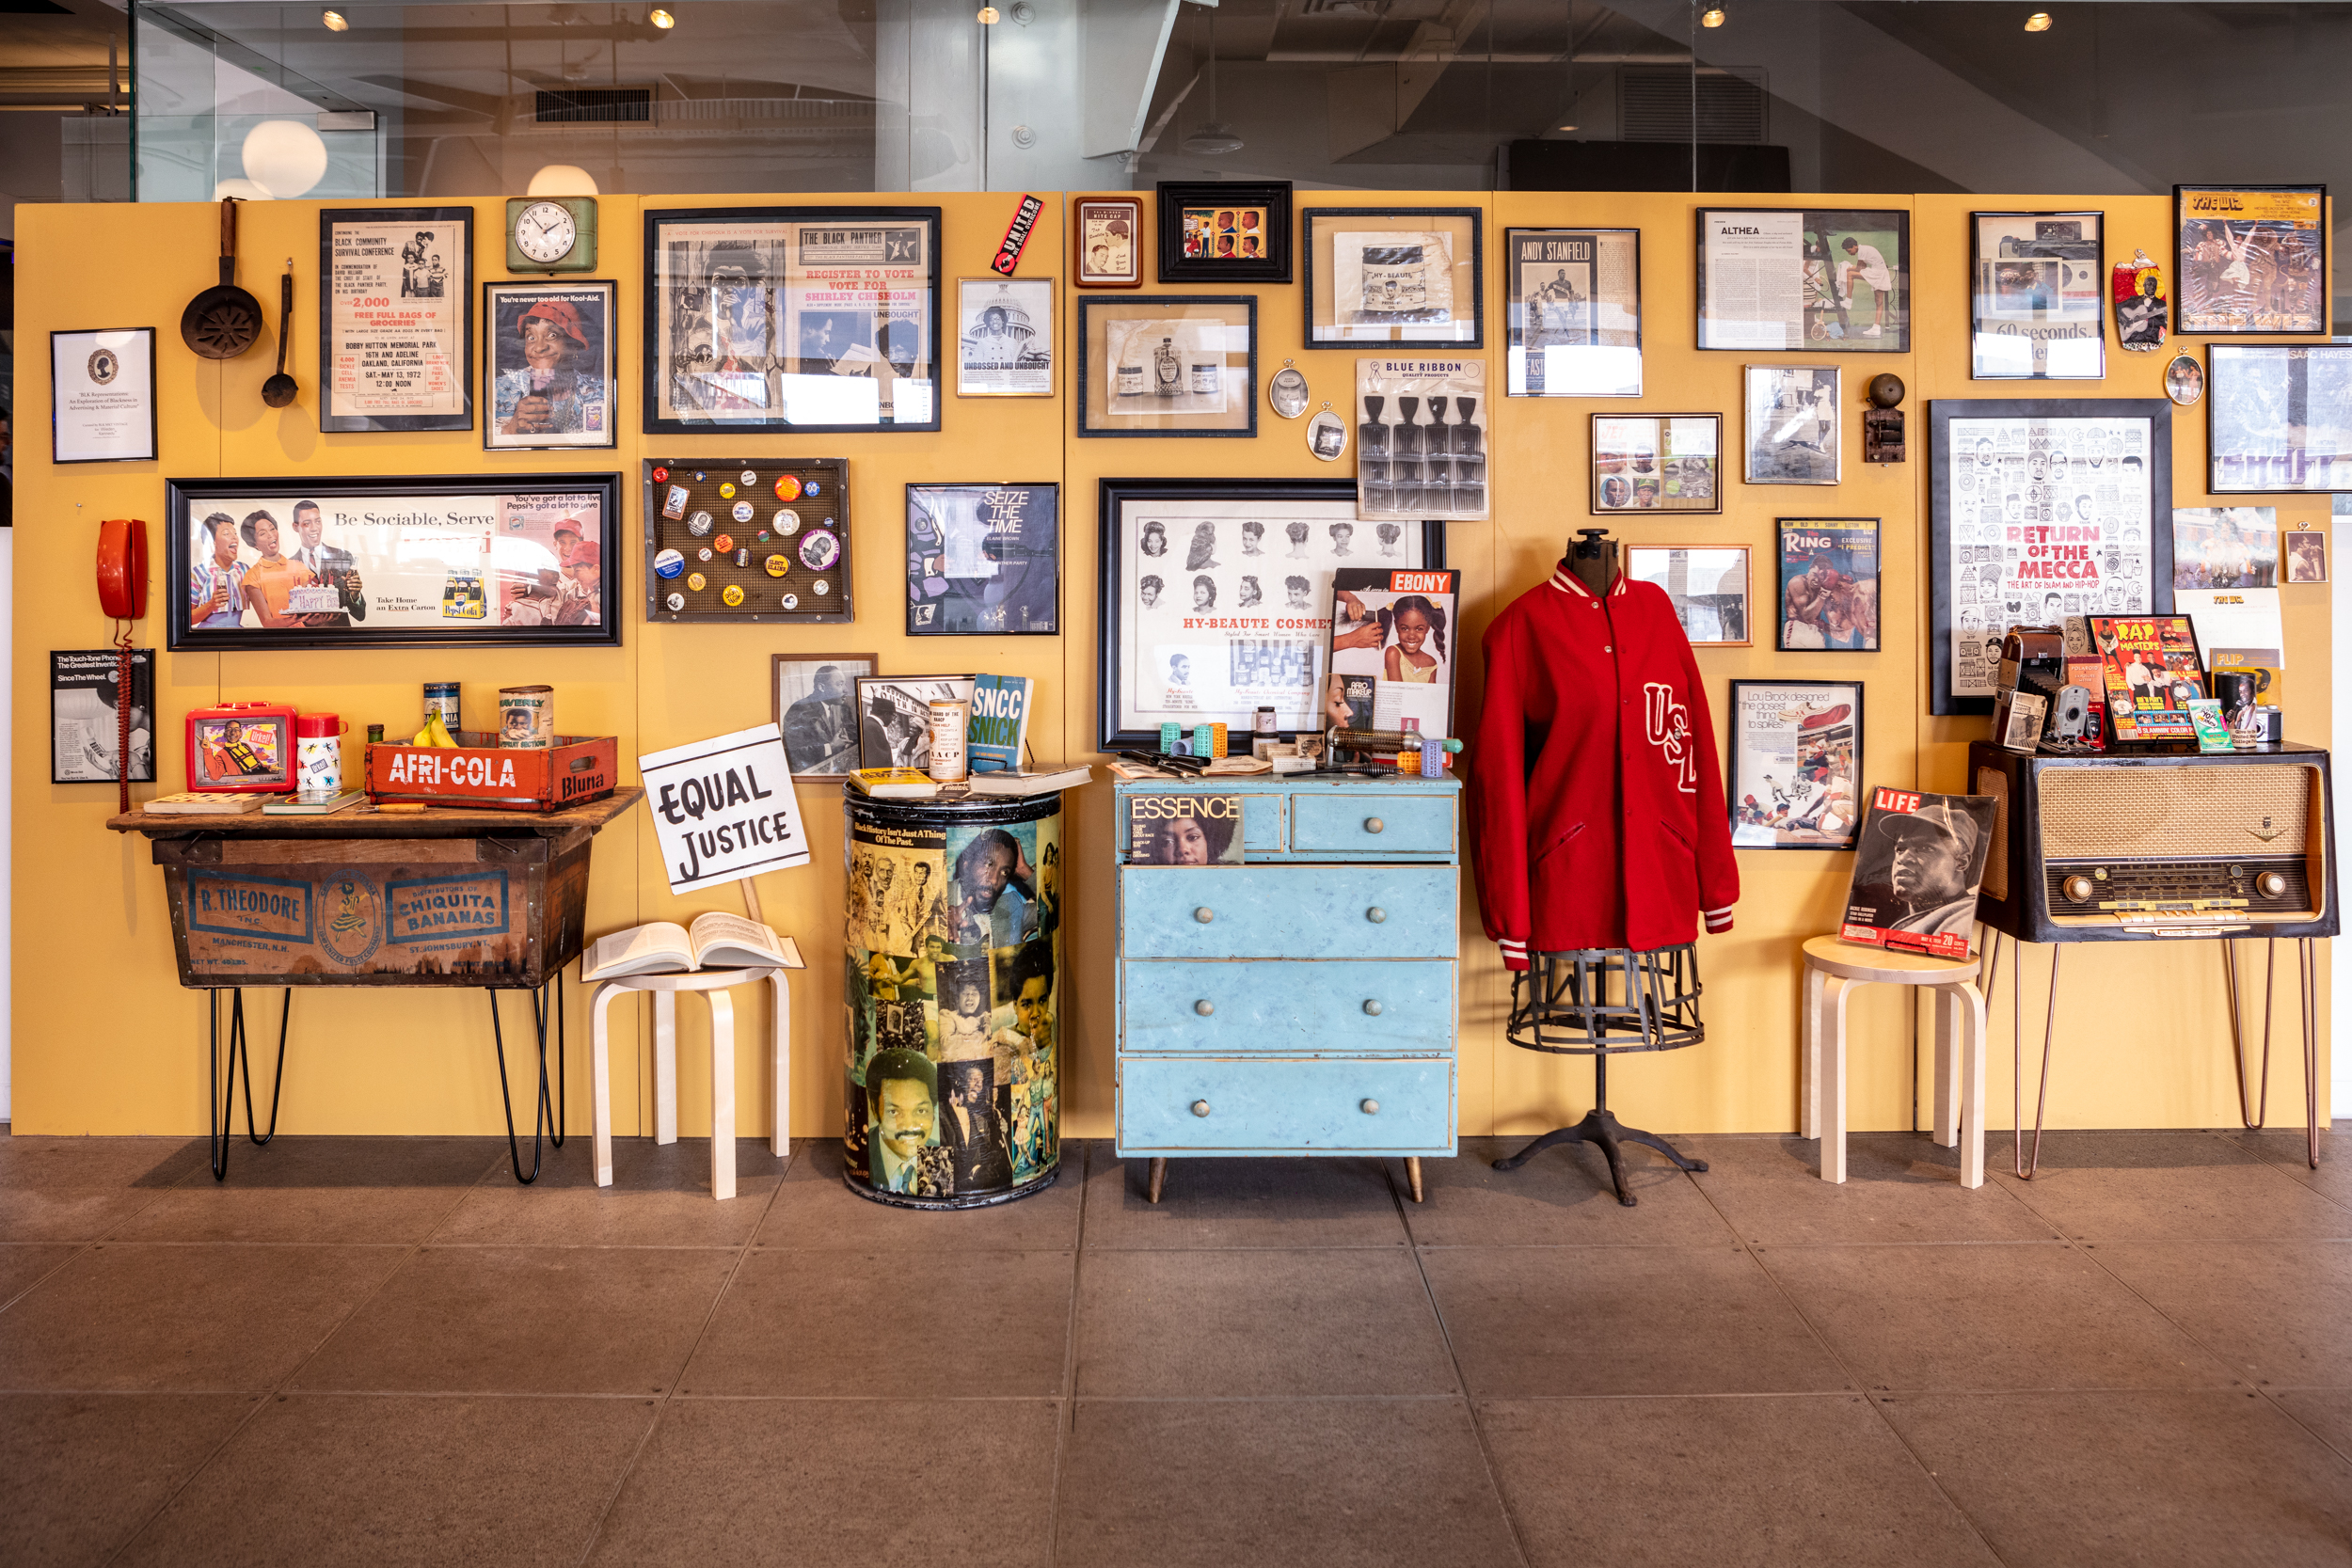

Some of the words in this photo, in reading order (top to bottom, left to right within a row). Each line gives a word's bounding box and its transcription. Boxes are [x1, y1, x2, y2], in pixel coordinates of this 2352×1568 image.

[2193, 196, 2217, 210] THE
[2218, 197, 2244, 211] WIZ
[1004, 198, 1036, 251] UNITED
[1012, 245, 1019, 256] WE
[1017, 230, 1028, 246] SHALL
[1025, 202, 1041, 229] OVERCOME
[1721, 227, 1759, 235] ALTHEA
[804, 232, 818, 245] THE
[823, 232, 845, 245] BLACK
[850, 232, 882, 244] PANTHER
[361, 247, 394, 256] CONFERENCE
[1521, 242, 1543, 261] ANDY
[1547, 242, 1590, 261] STANFIELD
[806, 270, 861, 278] REGISTER
[865, 270, 880, 278] TO
[884, 270, 914, 278] VOTE
[864, 281, 887, 290] FOR
[353, 297, 389, 309] 2,000
[805, 293, 853, 301] SHIRLEY
[858, 292, 916, 300] CHISHOLM
[2021, 323, 2092, 341] seconds.
[2288, 351, 2317, 359] ISAAC
[2320, 351, 2352, 359] HAYES
[964, 362, 999, 371] UNBOSSED
[1014, 361, 1050, 370] UNBOUGHT
[1386, 362, 1414, 372] BLUE
[1419, 363, 1461, 372] RIBBON
[542, 495, 556, 504] got
[984, 491, 1029, 505] SEIZE
[506, 502, 534, 511] Pepsi's
[535, 502, 549, 511] got
[580, 501, 598, 510] give
[991, 506, 1021, 519] THE
[334, 512, 358, 527] Be
[363, 512, 442, 527] Sociable,
[446, 512, 495, 525] Serve
[987, 519, 1023, 533] TIME
[1783, 532, 1831, 552] RING
[2007, 526, 2100, 544] RETURN
[2027, 546, 2049, 558] OF
[2051, 545, 2089, 560] THE
[2017, 561, 2099, 579] MECCA
[1394, 574, 1448, 592] EBONY
[2007, 580, 2020, 589] THE
[2062, 580, 2074, 589] AND
[2074, 580, 2100, 589] HIP-HOP
[1183, 618, 1269, 628] HY-BEAUTE
[2116, 624, 2154, 641] RAP
[2120, 641, 2160, 651] MASTERS
[2217, 654, 2244, 665] FLIP
[971, 688, 1022, 720] SNCC
[1747, 691, 1764, 702] Lou
[1765, 691, 1790, 702] Brock
[1790, 692, 1830, 703] designed
[1755, 702, 1787, 711] closest
[1756, 710, 1776, 721] thing
[968, 715, 1020, 748] SNICK
[1748, 720, 1759, 729] to
[252, 731, 270, 745] Urkel!
[311, 760, 326, 773] Urkel!
[389, 752, 516, 787] AFRI-COLA
[562, 772, 604, 800] Bluna
[659, 765, 772, 825] EQUAL
[1876, 791, 1919, 812] LIFE
[1132, 798, 1240, 819] ESSENCE
[854, 822, 867, 832] Black
[866, 825, 887, 836] History
[887, 828, 901, 837] Isn't
[901, 829, 917, 838] Just
[924, 831, 946, 840] Thing
[679, 811, 791, 881] JUSTICE
[876, 835, 884, 844] Of
[883, 836, 897, 845] The
[896, 837, 914, 846] Past.
[413, 885, 464, 896] DISTRIBUTORS
[399, 895, 495, 917] CHIQUITA
[238, 916, 263, 926] INC.
[406, 911, 495, 931] BANANAS
[212, 937, 270, 951] MANCHESTER,
[272, 944, 290, 953] N.H.
[1943, 935, 1953, 946] 20
